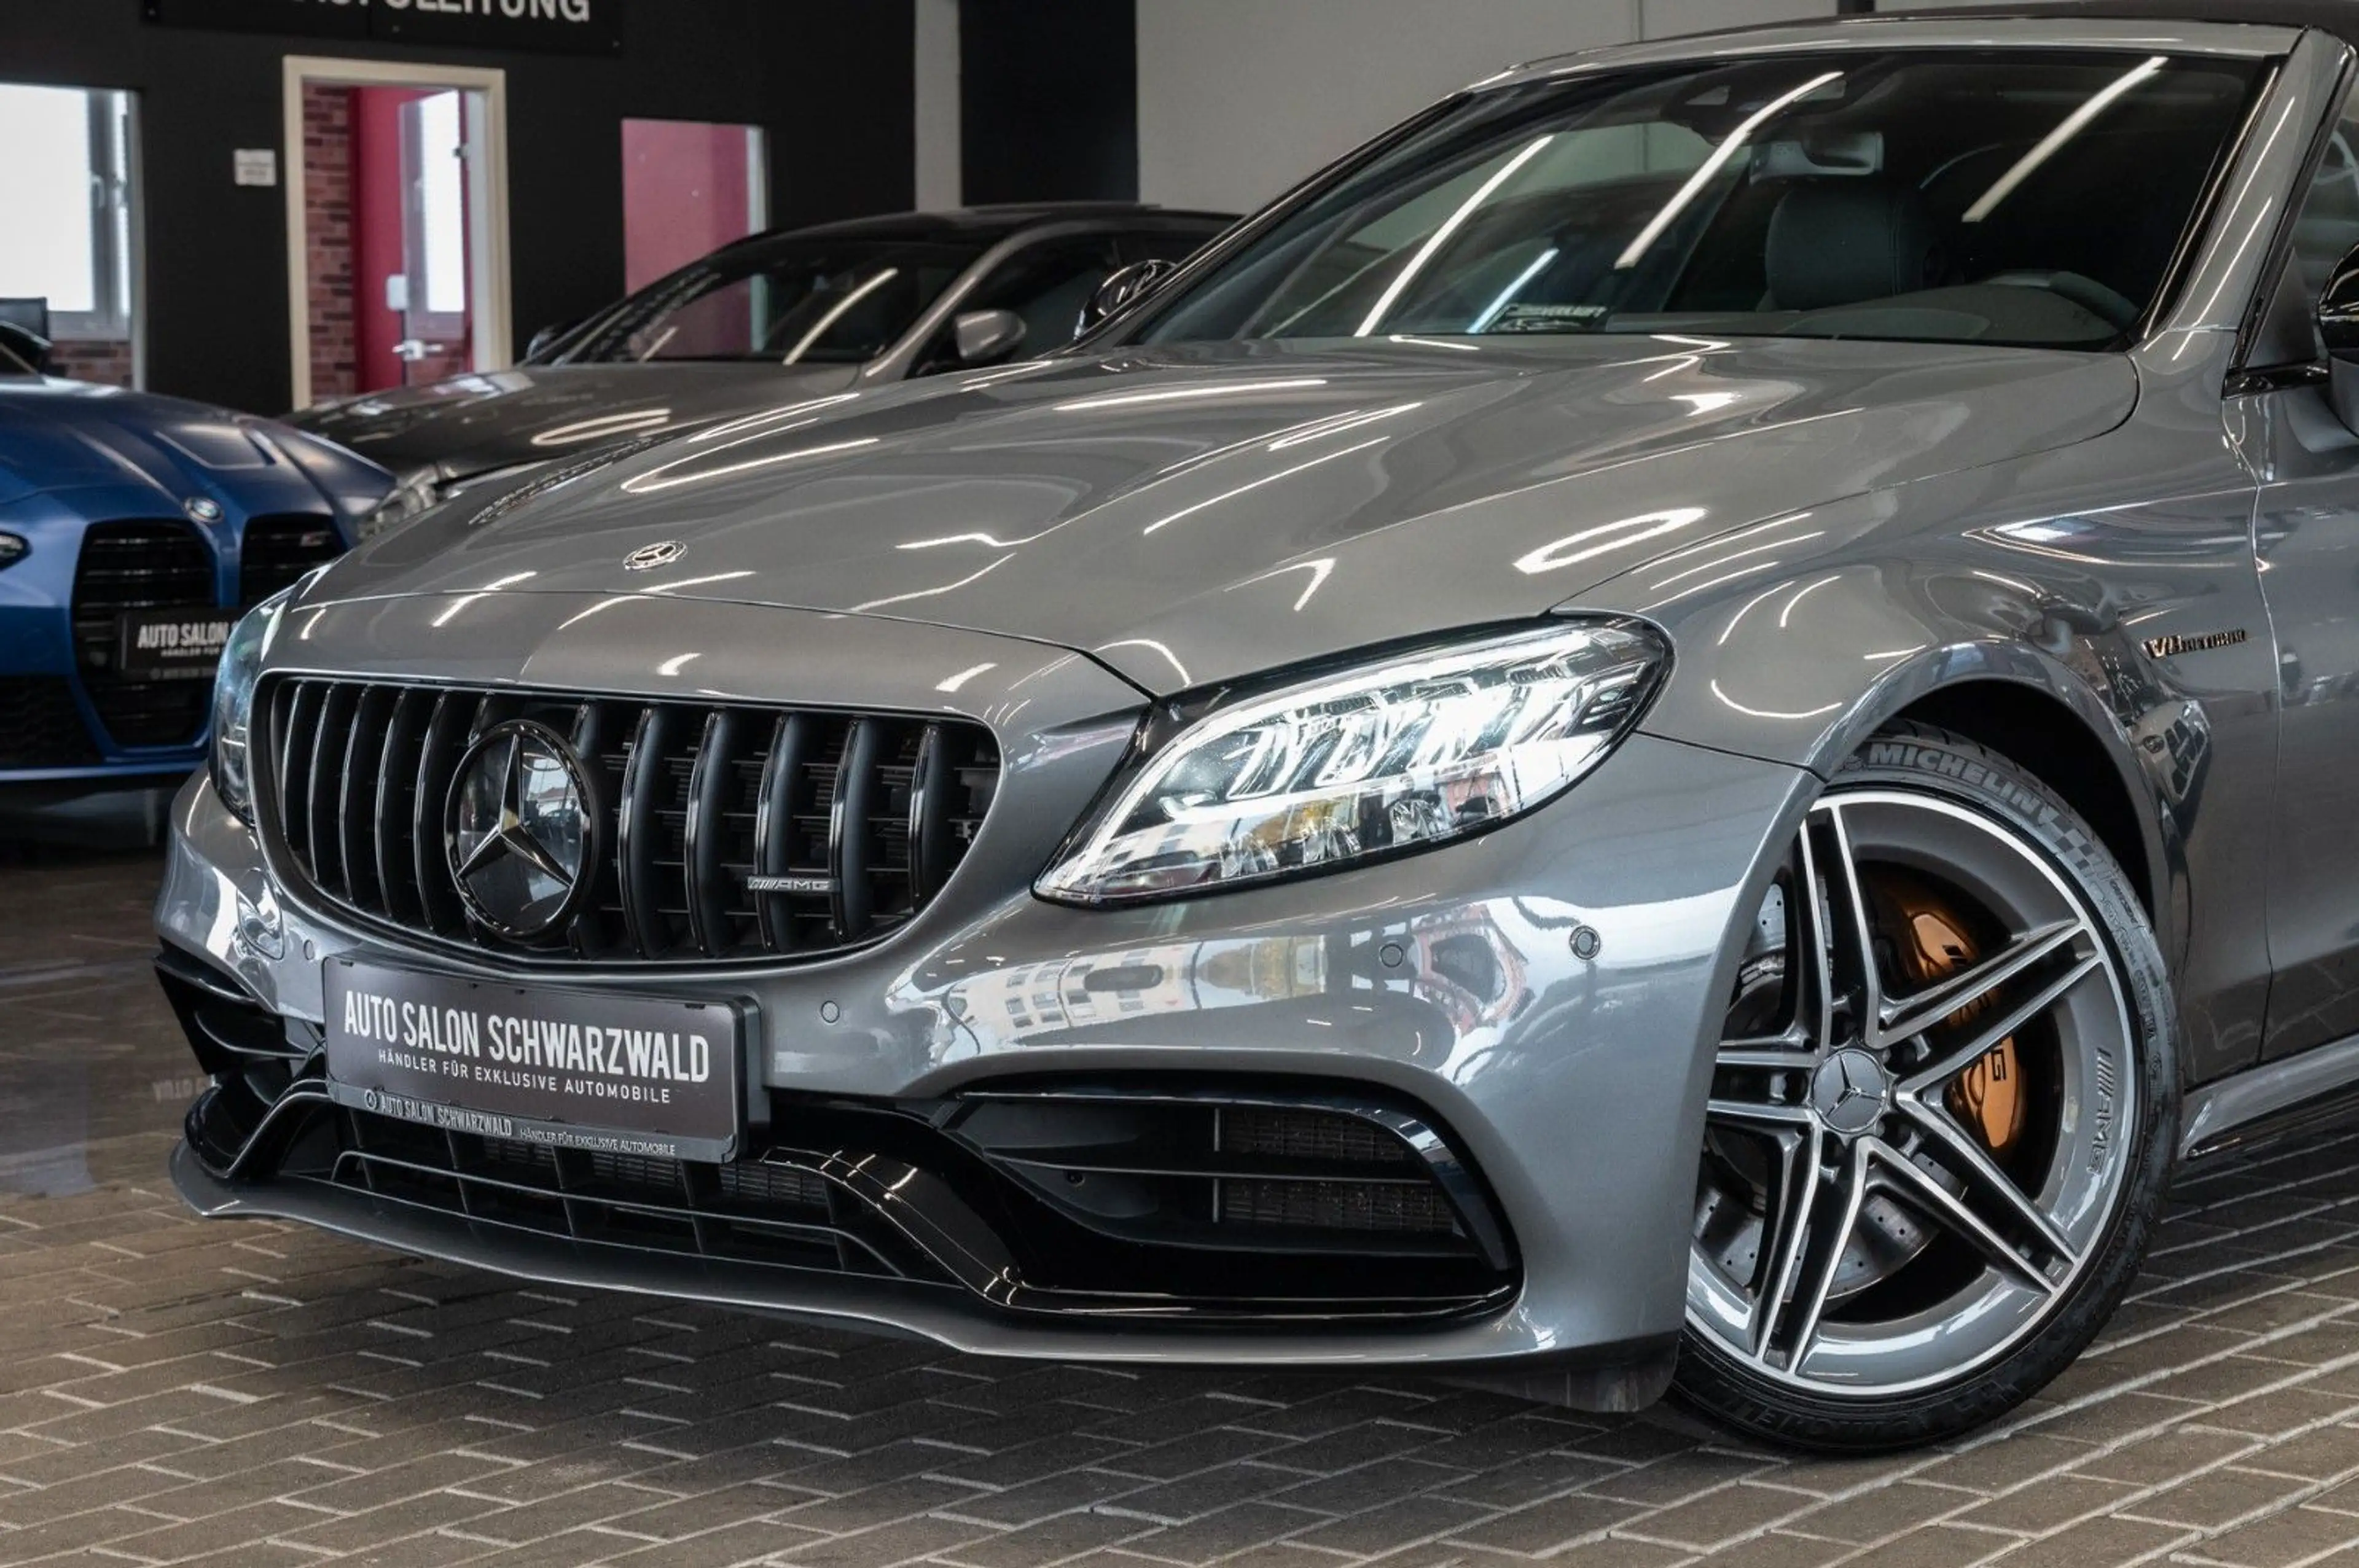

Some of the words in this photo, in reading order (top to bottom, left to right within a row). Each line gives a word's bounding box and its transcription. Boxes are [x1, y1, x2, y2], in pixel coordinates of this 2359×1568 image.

[137, 624, 179, 649] AUTO
[181, 622, 229, 647] SALON
[1869, 743, 2041, 816] MICHELIN
[344, 990, 397, 1043] AUTO
[402, 1001, 480, 1058] SALON
[488, 1015, 709, 1083] SCHWARZWALD
[378, 1048, 437, 1073] HÄNDLER
[442, 1059, 469, 1078] FÜR
[475, 1066, 557, 1092] EXKLUSIVE
[564, 1078, 671, 1104] AUTOMOBILE
[381, 1094, 404, 1118] AUTO
[404, 1099, 435, 1123] SALON
[437, 1106, 512, 1136] SCHWARZWALD
[619, 1140, 676, 1156] AUTOMOBILE
